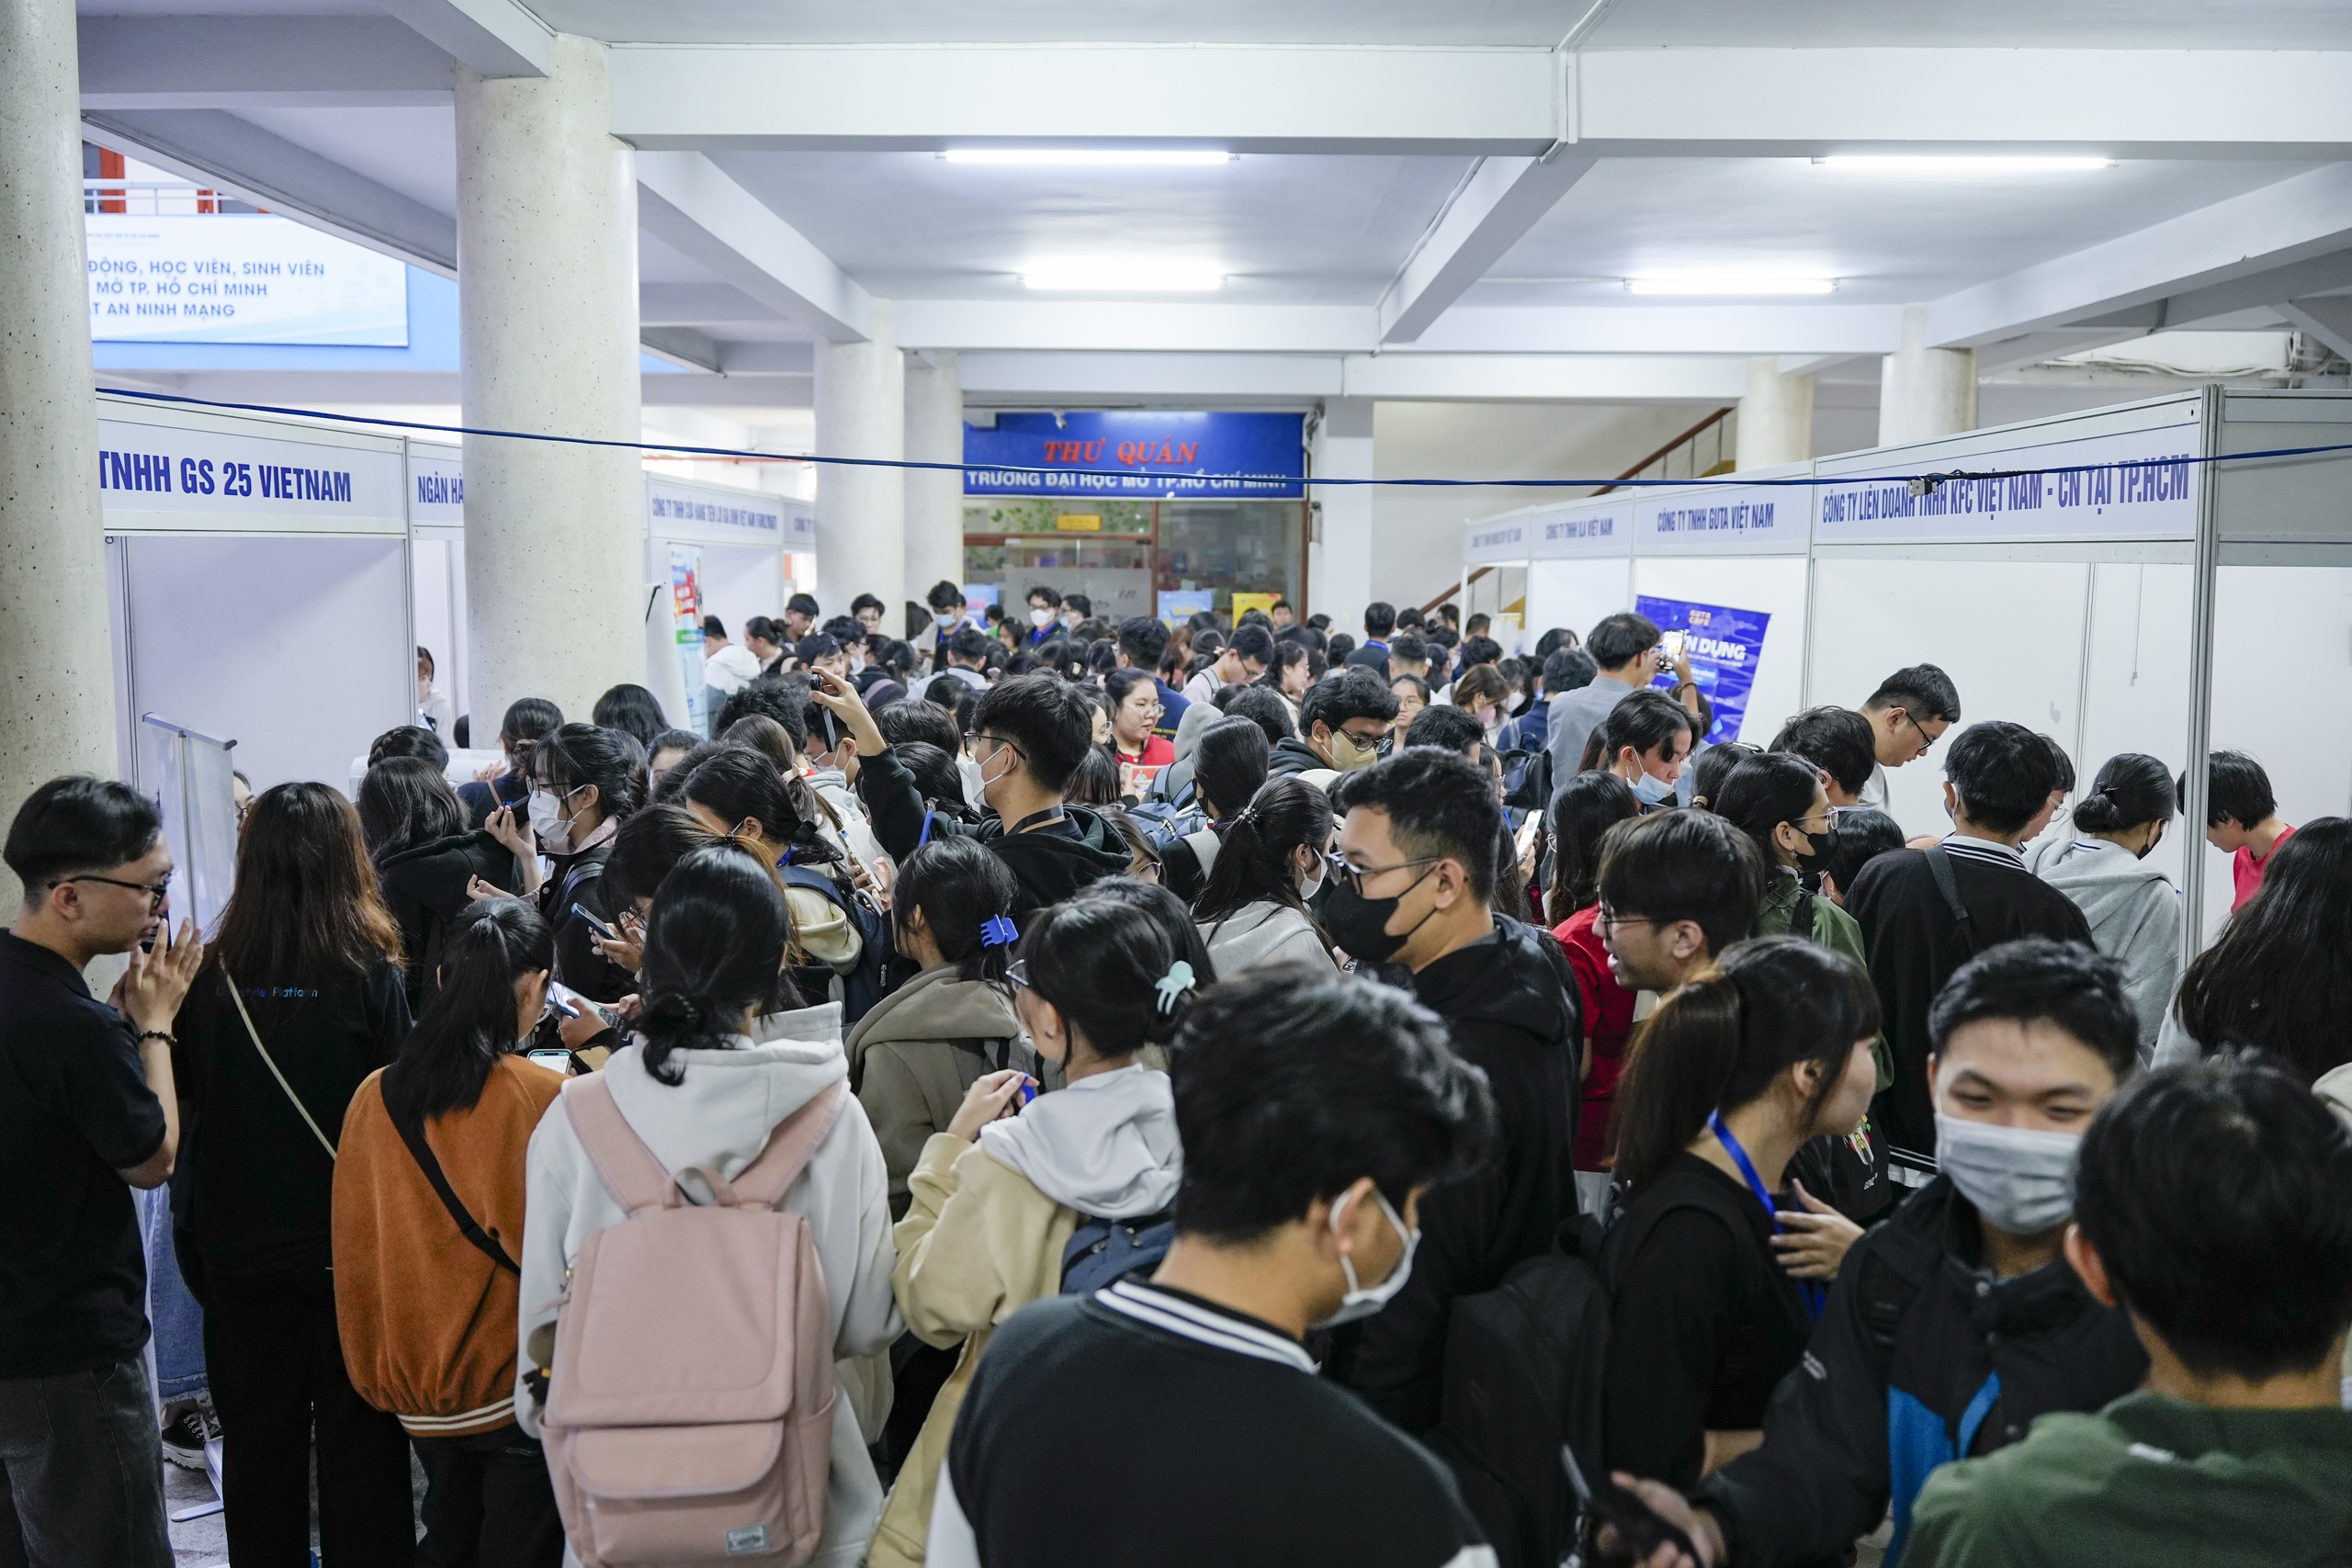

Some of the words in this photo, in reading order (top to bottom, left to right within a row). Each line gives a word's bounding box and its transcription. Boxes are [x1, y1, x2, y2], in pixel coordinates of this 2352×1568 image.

[150, 261, 187, 277] HỌC
[194, 258, 236, 278] VIÊN,
[243, 262, 280, 275] SINH
[288, 259, 324, 276] VIÊN
[96, 276, 123, 294] MỞ
[130, 282, 150, 294] TP.
[157, 276, 181, 294] HỒ
[187, 279, 218, 295] CHÍ
[224, 283, 267, 295] MINH
[107, 303, 129, 314] AN
[136, 303, 176, 315] NINH
[184, 304, 235, 321] MẠNG
[1044, 437, 1107, 462] THƯ
[1117, 435, 1199, 466] QUÁN
[99, 450, 172, 492] TNHH
[180, 457, 215, 495] GS
[223, 462, 252, 497] 25
[258, 465, 351, 502] VIETNAM
[418, 470, 448, 503] NGÂN
[1046, 472, 1076, 490] ĐẠI
[1080, 474, 1117, 490] HỌC
[1823, 489, 1845, 524] CÔNG
[1848, 491, 1858, 521] TY
[1859, 484, 1879, 521] LIÊN
[1882, 485, 1916, 519] DOANH
[1951, 479, 1973, 514] KFC
[1977, 468, 2005, 520] VIỆT
[2008, 473, 2042, 511] NAM
[2058, 470, 2080, 507] CN
[2086, 462, 2112, 514] TẠI
[2118, 454, 2189, 503] TP.HCM
[1657, 507, 1676, 532] CÔNG
[1679, 510, 1687, 531] TY
[1688, 508, 1707, 530] TNHH
[1709, 507, 1728, 529] GUTA
[1732, 500, 1749, 535] VIỆT
[1752, 502, 1774, 528] NAM
[1698, 637, 1747, 660] DỤNG
